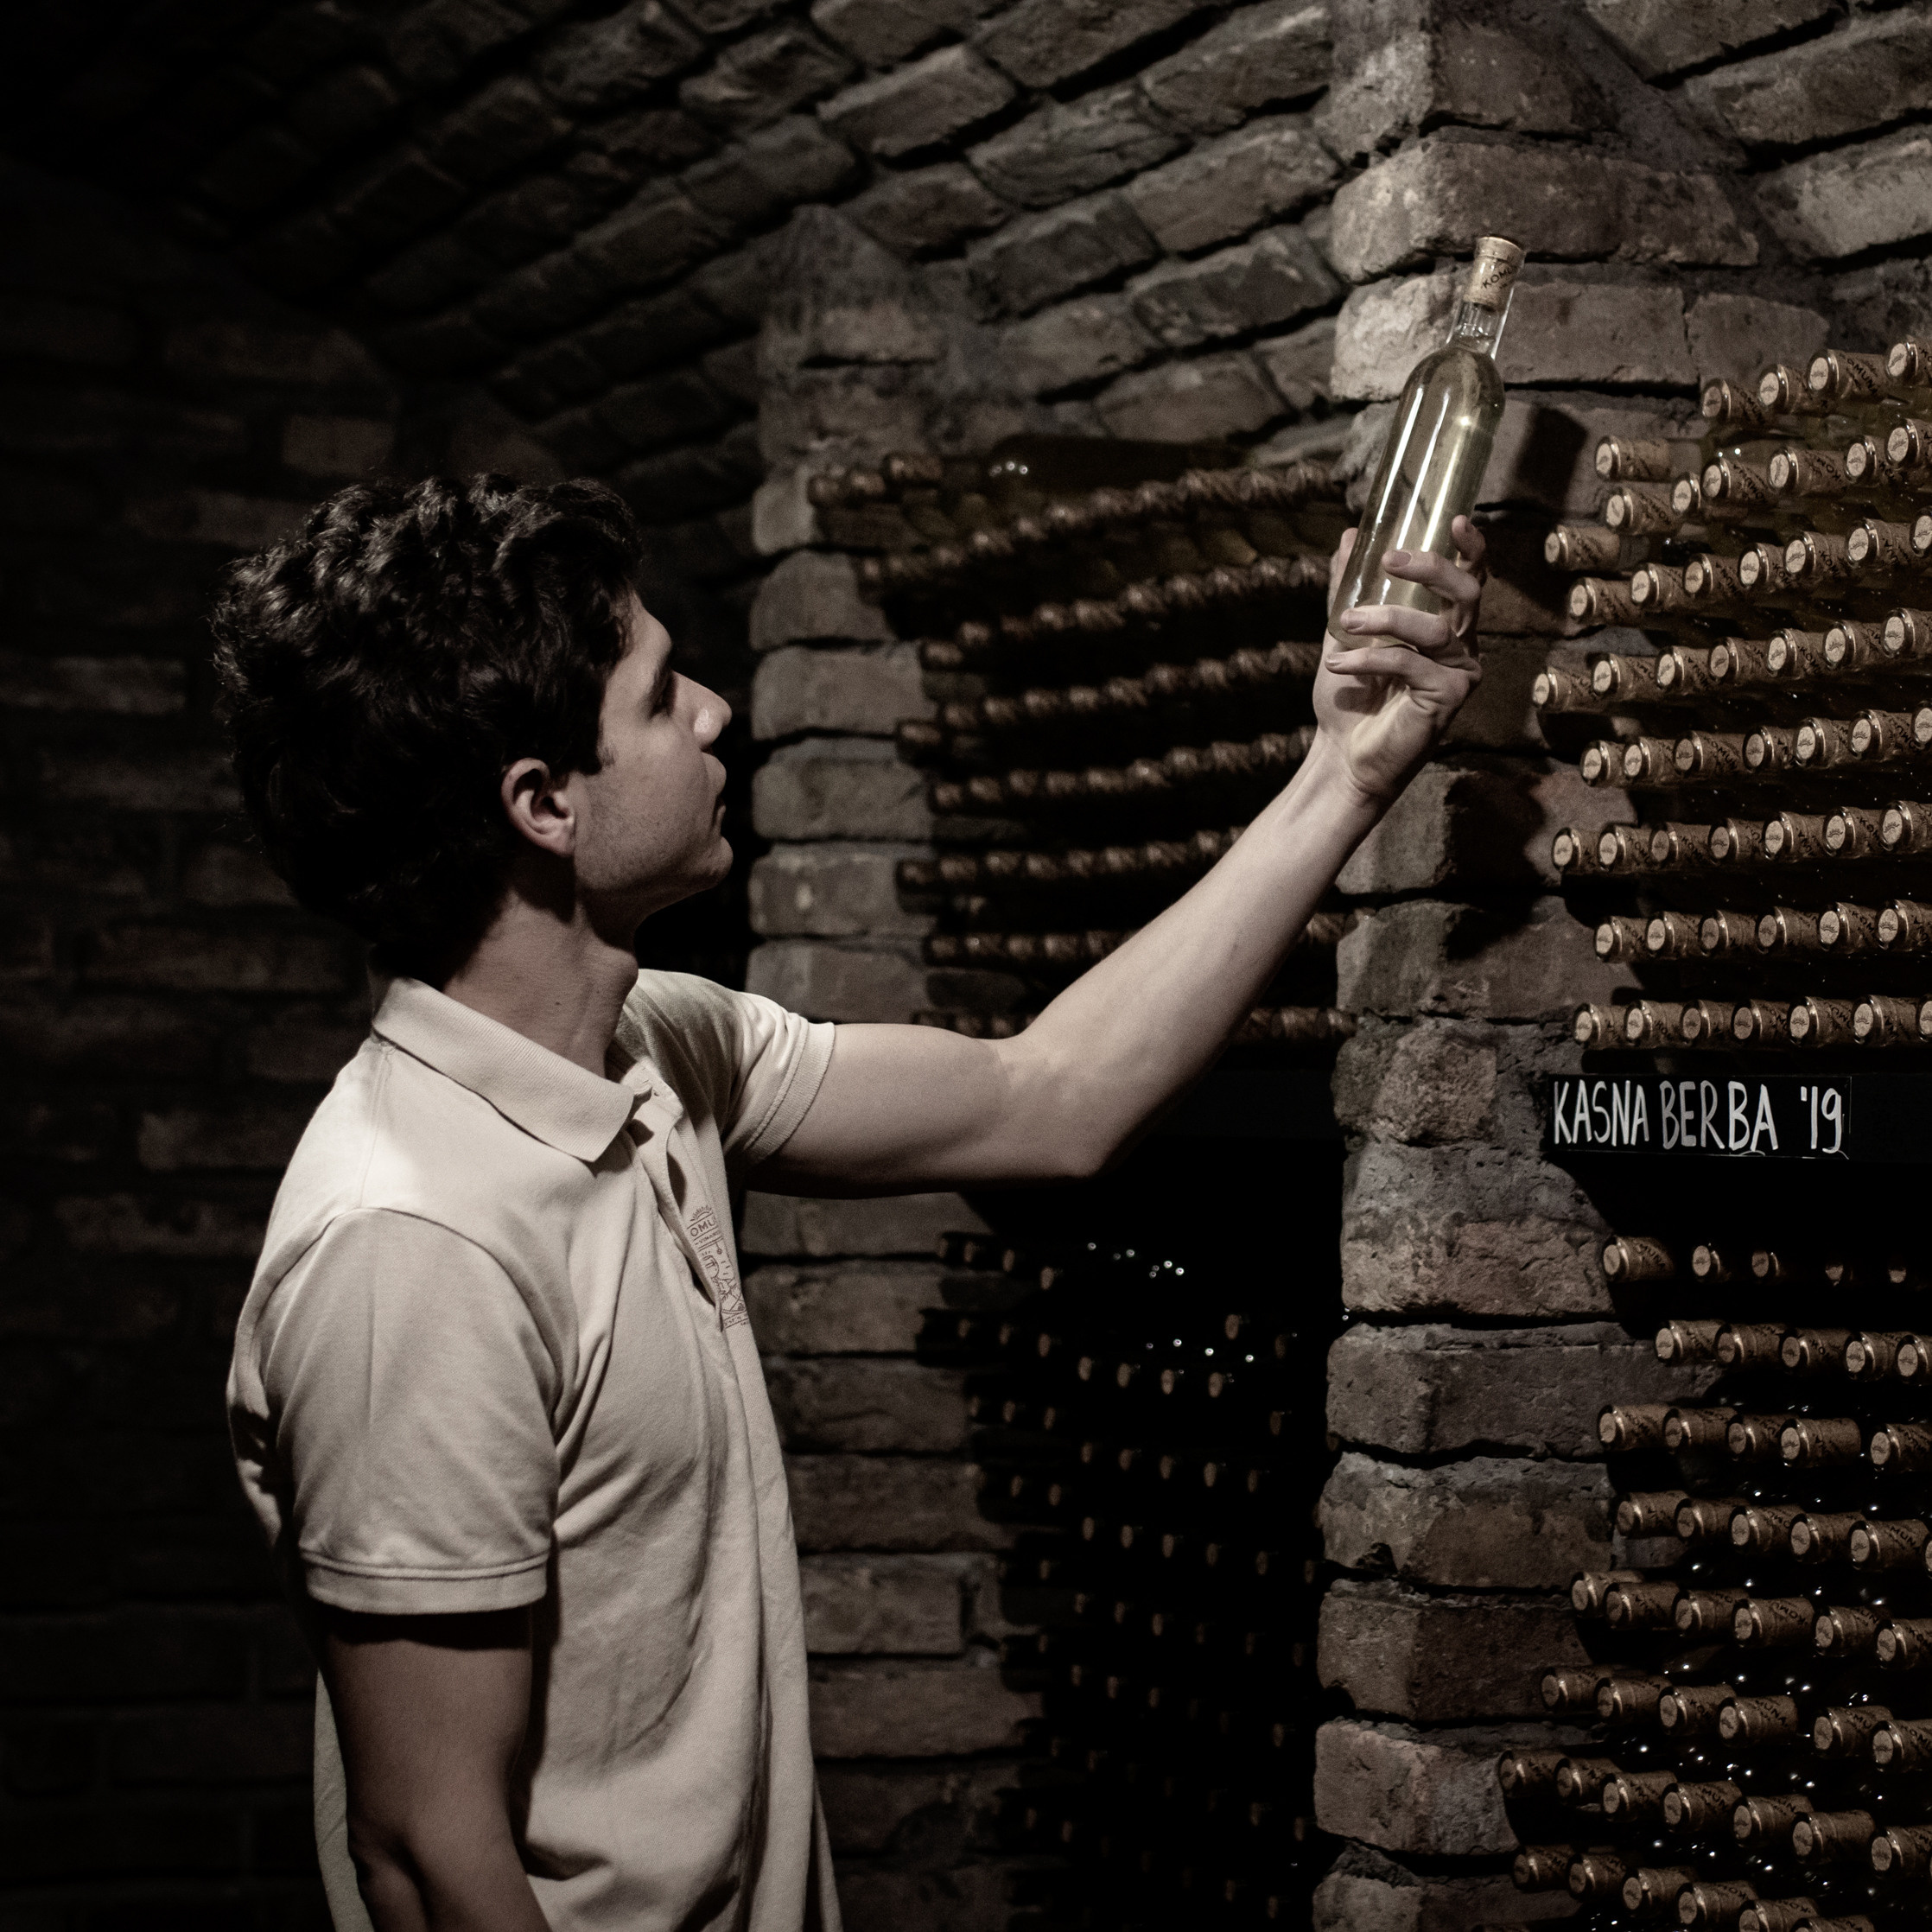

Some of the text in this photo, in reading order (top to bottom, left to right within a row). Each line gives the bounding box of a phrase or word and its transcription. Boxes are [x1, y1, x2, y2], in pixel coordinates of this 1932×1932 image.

[1554, 1079, 1842, 1153] KASNA BERBA '19
